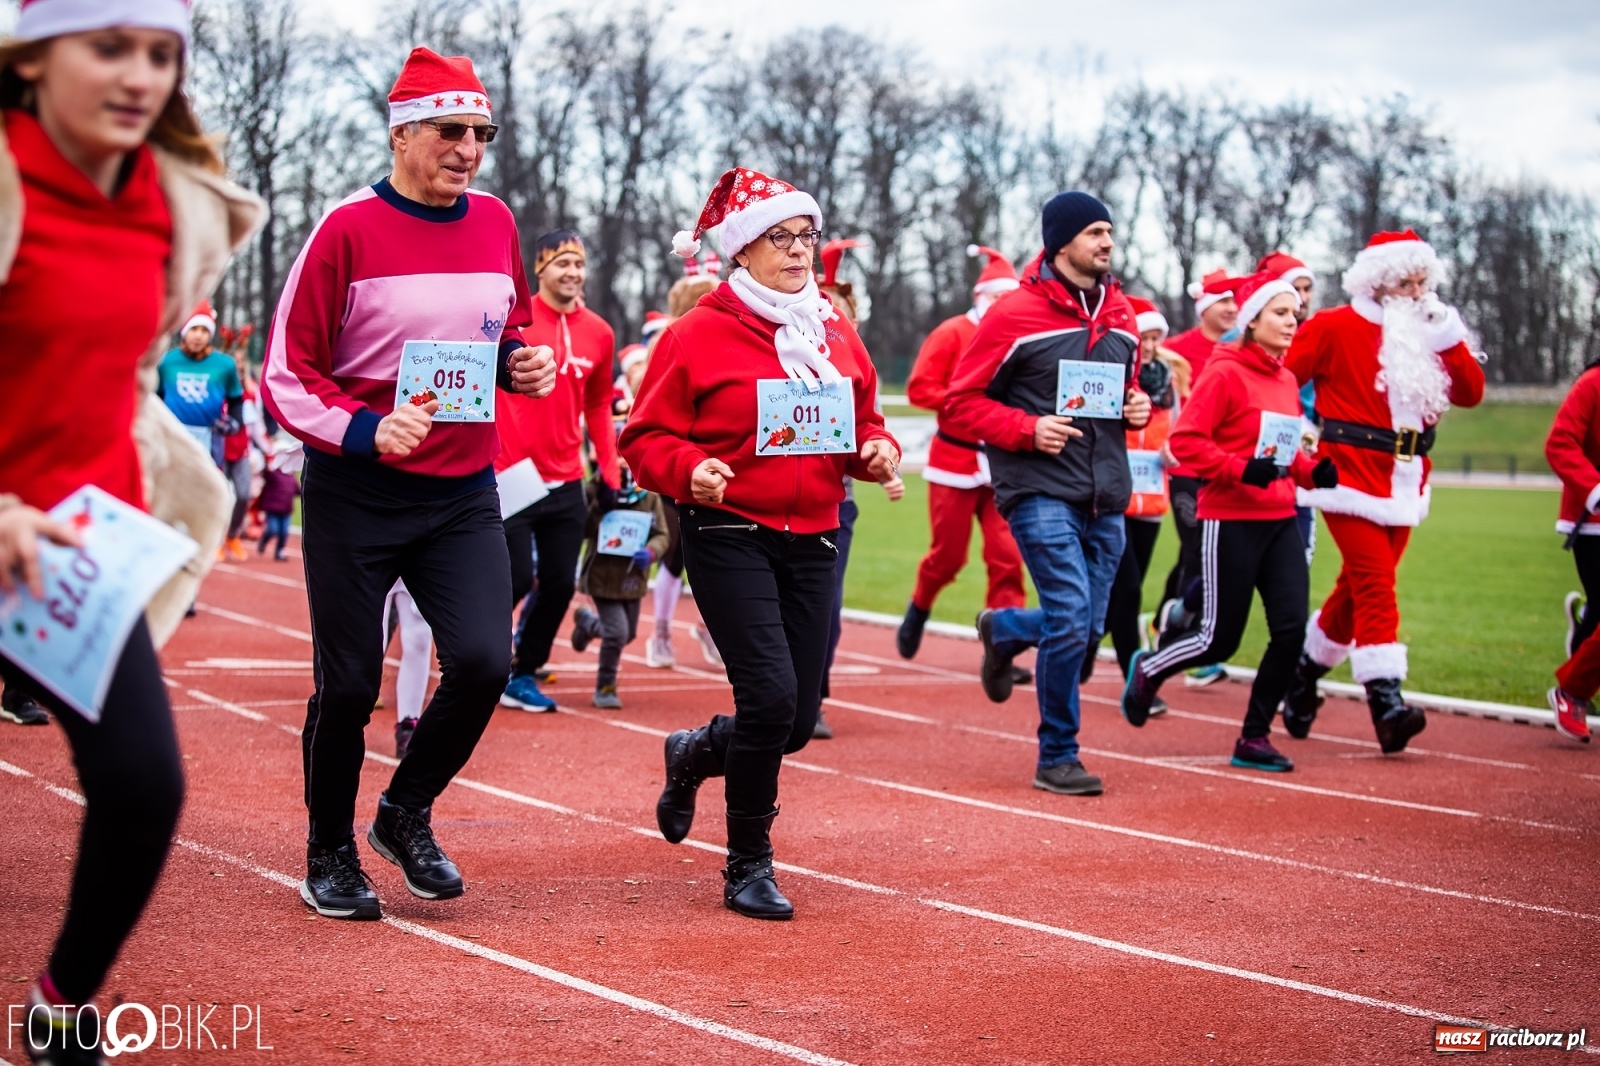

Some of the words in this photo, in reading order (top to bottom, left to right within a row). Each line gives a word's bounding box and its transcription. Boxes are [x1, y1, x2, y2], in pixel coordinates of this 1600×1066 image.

[433, 368, 466, 390] 015
[1083, 381, 1104, 395] 019
[793, 405, 820, 424] 011
[47, 550, 100, 630] 073
